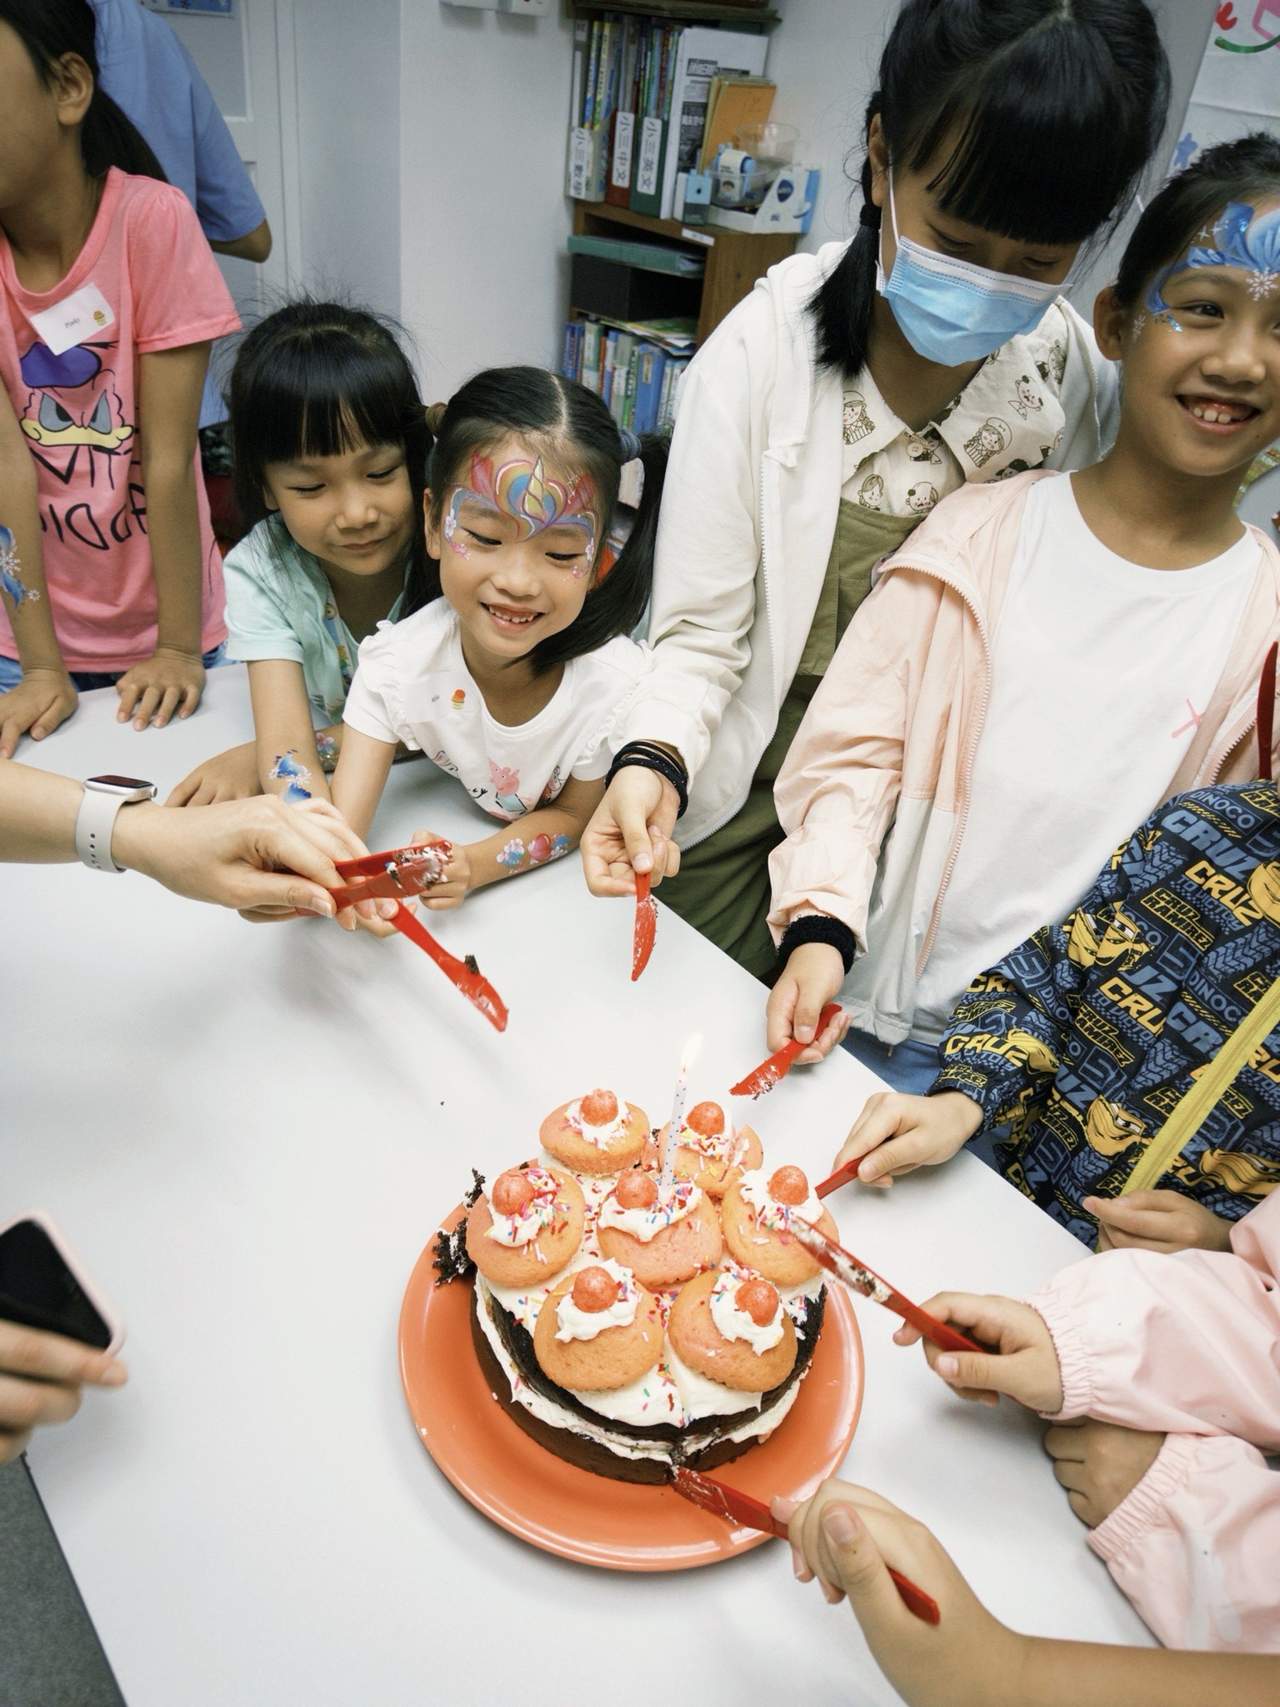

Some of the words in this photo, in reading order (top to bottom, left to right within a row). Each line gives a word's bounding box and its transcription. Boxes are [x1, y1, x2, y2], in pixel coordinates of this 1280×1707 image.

[1189, 790, 1256, 829] DINOCO
[1161, 809, 1261, 881] CRUZ
[1155, 889, 1201, 922] CRUZ
[1176, 874, 1198, 892] TO
[1185, 860, 1265, 926] CRUZ
[1143, 895, 1212, 950] RAMIREZ
[1100, 977, 1166, 1035] CRU
[1188, 969, 1246, 1024] DINOC
[945, 1033, 1030, 1068] CRUZ
[1075, 1017, 1133, 1067] AMIREZ
